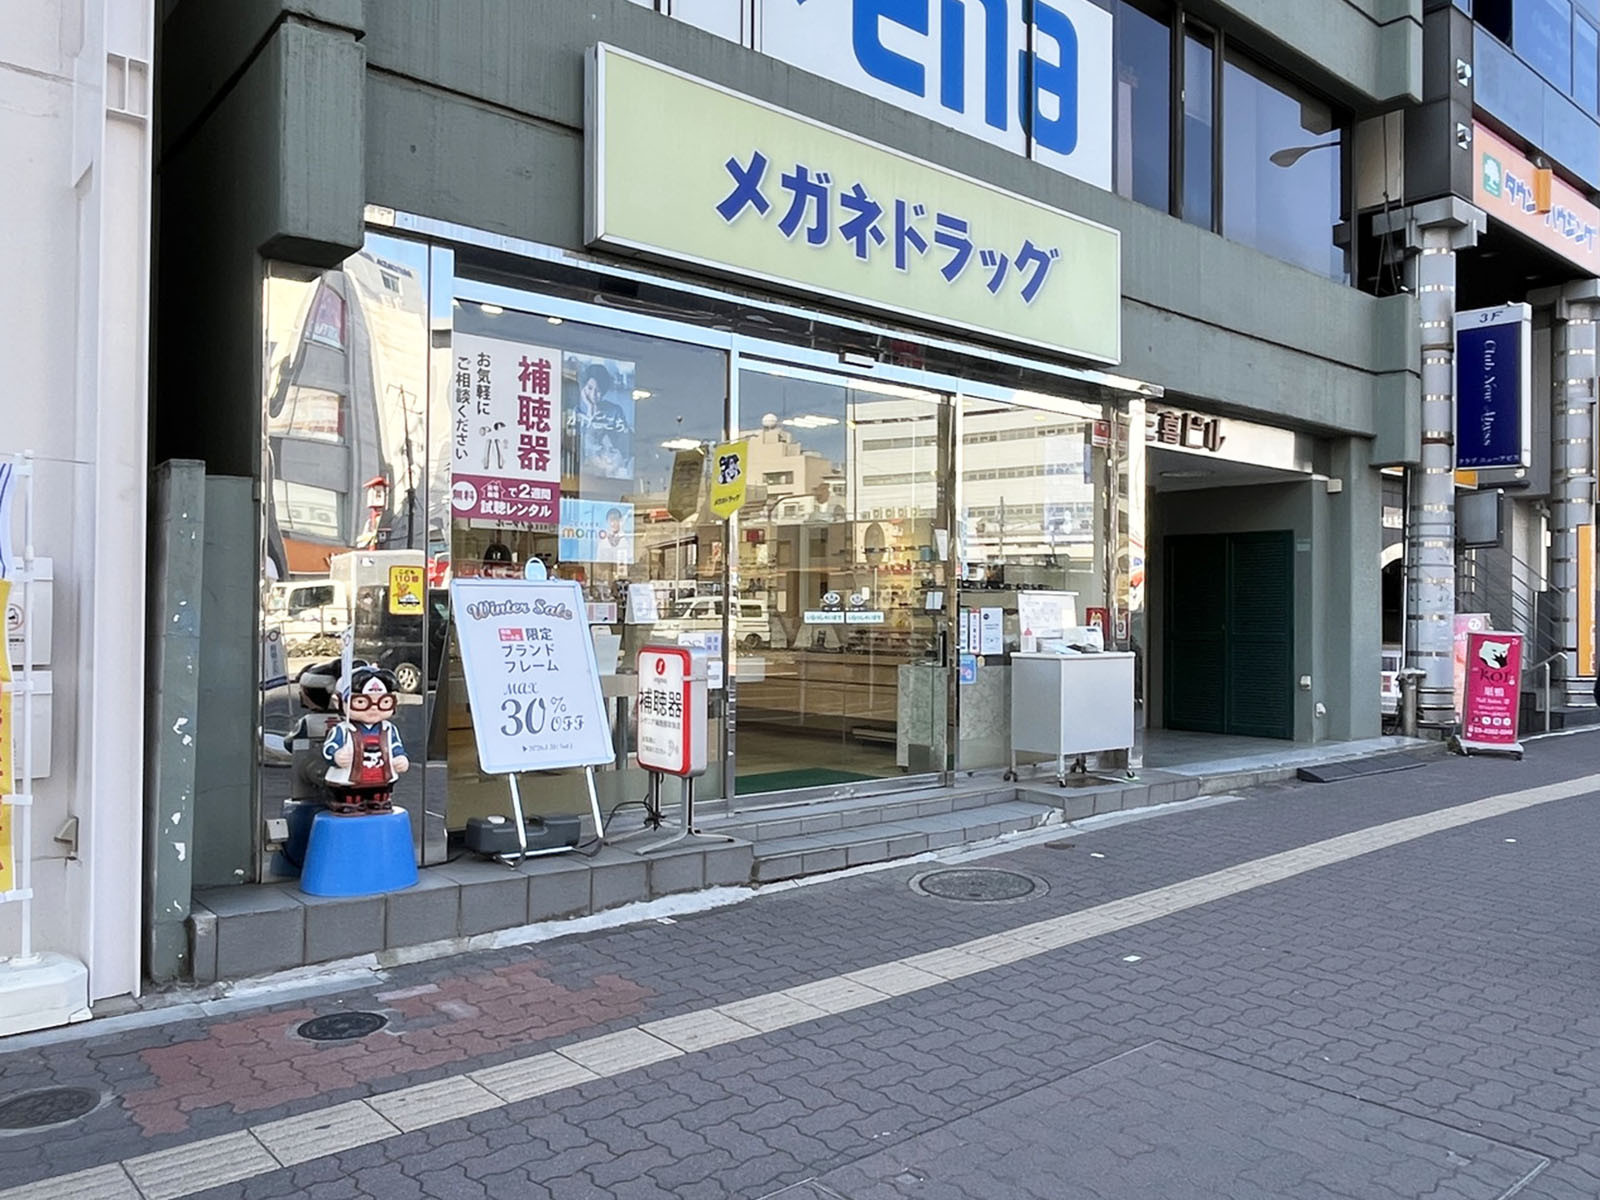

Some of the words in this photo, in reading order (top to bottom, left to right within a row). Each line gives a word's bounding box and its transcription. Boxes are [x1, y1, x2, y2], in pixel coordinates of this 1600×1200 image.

[715, 149, 1060, 306] メガネドラッグ
[1479, 310, 1504, 324] 3F
[1483, 339, 1497, 372] Club
[476, 352, 492, 416] お気軽に
[455, 356, 472, 461] ご相談ください
[517, 355, 552, 473] 補聴器
[452, 488, 475, 502] 無料
[480, 500, 552, 518] 試聴レンタル
[466, 600, 530, 620] Winter
[532, 599, 573, 620] Sale
[525, 628, 553, 641] 限定
[501, 643, 555, 658] ブランド
[504, 660, 559, 674] フレーム
[503, 682, 539, 696] MAX
[639, 687, 682, 719] 補聴器
[551, 715, 585, 732] OFF
